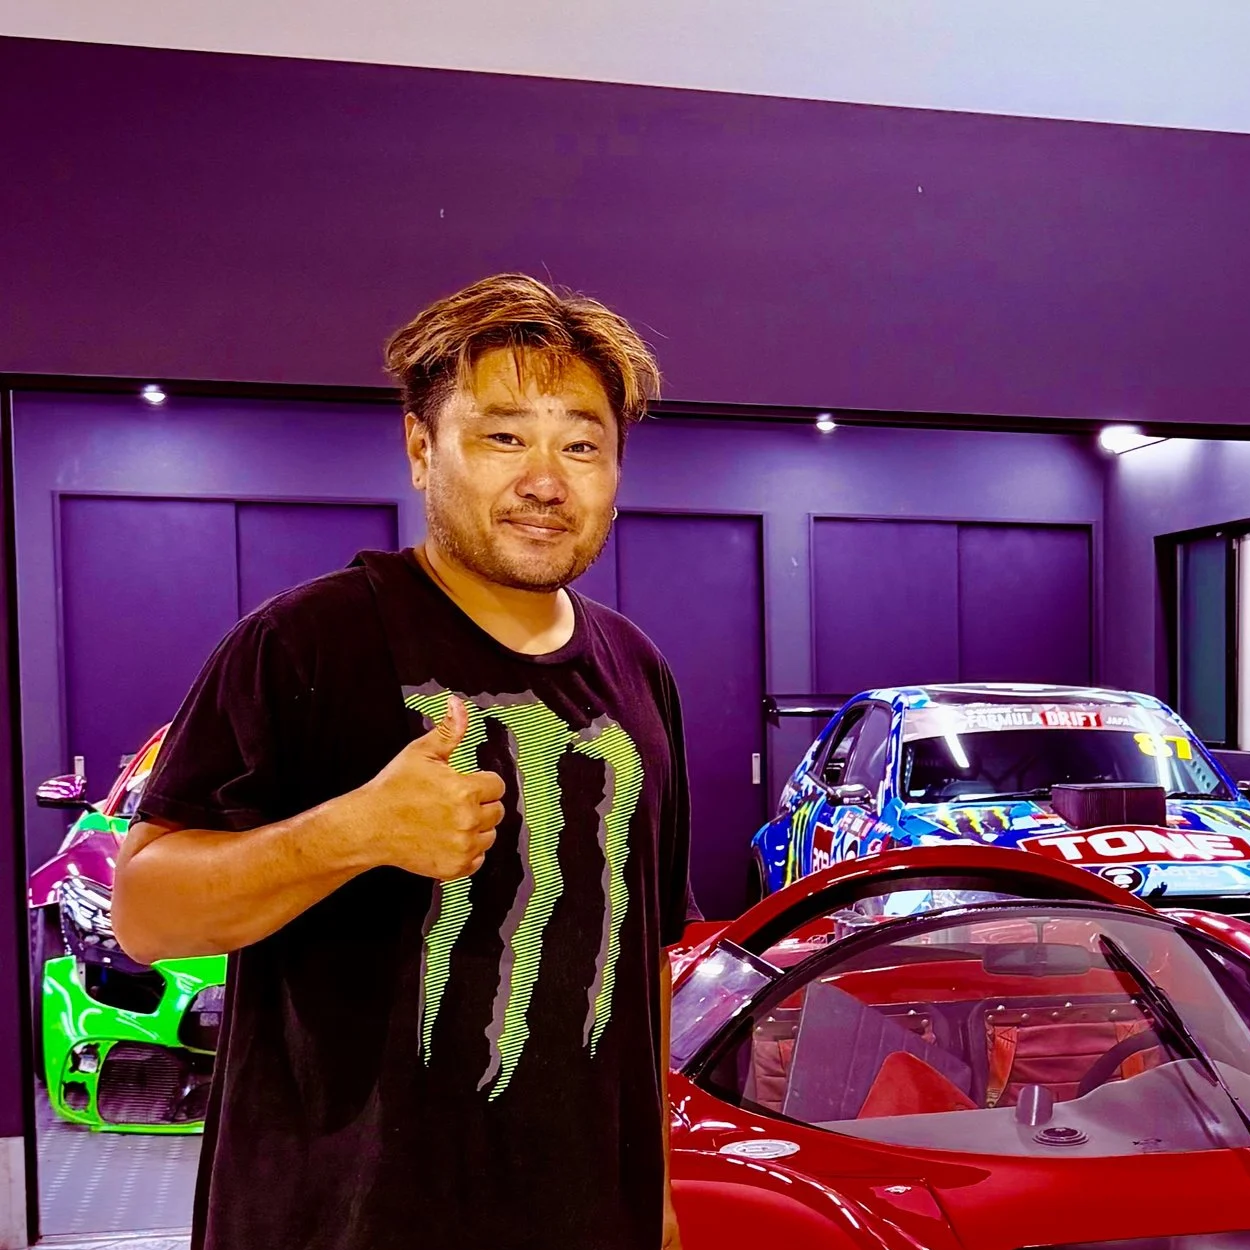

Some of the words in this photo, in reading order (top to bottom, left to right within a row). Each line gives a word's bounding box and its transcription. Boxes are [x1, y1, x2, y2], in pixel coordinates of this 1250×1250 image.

[967, 711, 1042, 729] FORMULA
[1045, 710, 1100, 728] DRIFT
[1133, 732, 1192, 760] 87
[1038, 829, 1245, 861] TONE
